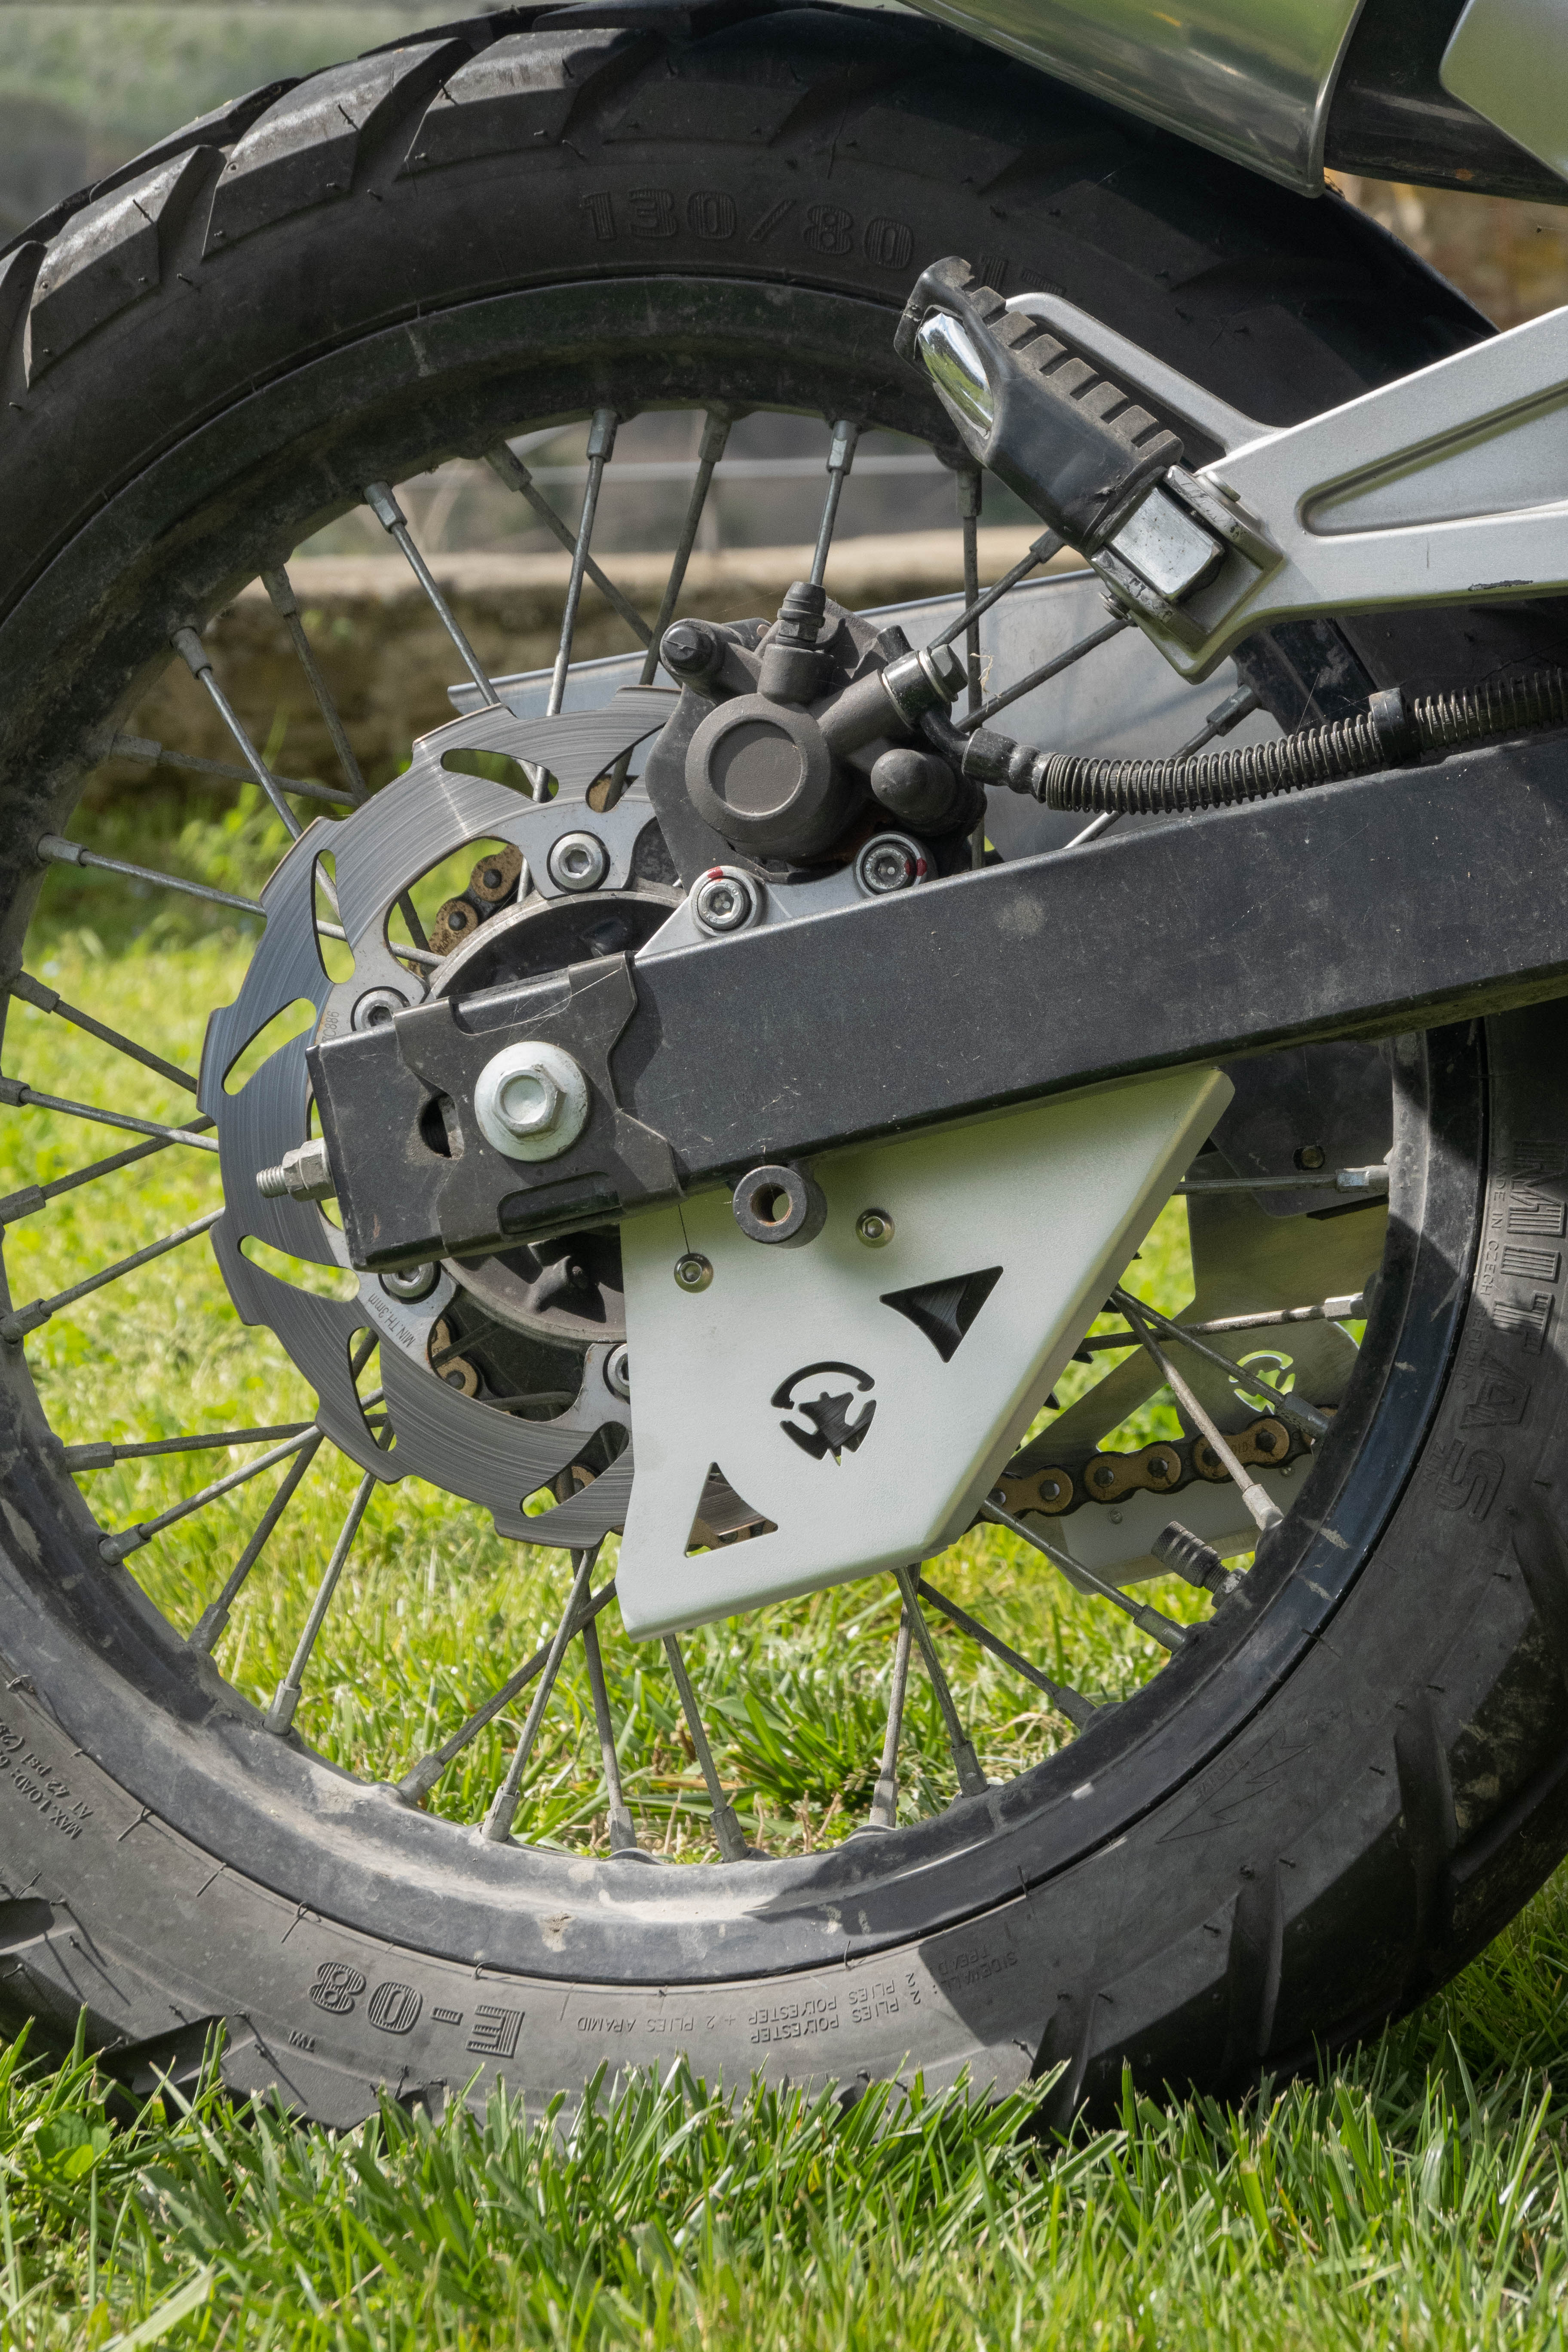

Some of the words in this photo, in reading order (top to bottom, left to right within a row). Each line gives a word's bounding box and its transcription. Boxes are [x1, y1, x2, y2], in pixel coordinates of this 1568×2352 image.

[579, 188, 915, 270] 130/80
[1494, 1155, 1507, 1202] MADE
[1491, 1212, 1504, 1229] IN
[1480, 1240, 1499, 1295] CZECH
[1435, 1140, 1566, 1522] MITAS
[71, 1801, 94, 1819] AT
[905, 1972, 916, 1987] 2
[848, 1980, 895, 2005] PLIES
[913, 1990, 921, 2005] 2
[307, 1961, 526, 2059] E-08
[706, 2015, 715, 2030] 2
[749, 1995, 837, 2025] POLYESTER
[852, 1997, 900, 2023] PLIES
[577, 2016, 637, 2033] ARAMID
[647, 2018, 694, 2032] PLIES
[750, 2014, 839, 2043] POLYESTER
